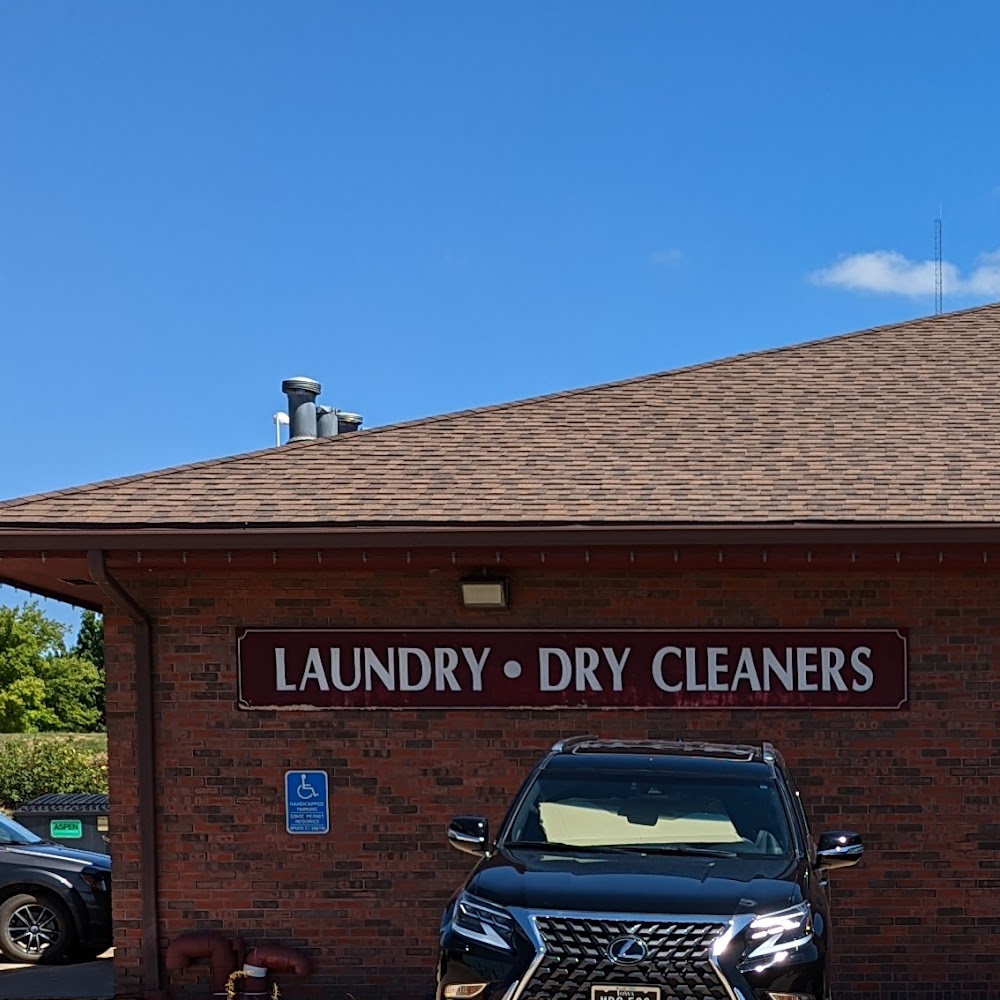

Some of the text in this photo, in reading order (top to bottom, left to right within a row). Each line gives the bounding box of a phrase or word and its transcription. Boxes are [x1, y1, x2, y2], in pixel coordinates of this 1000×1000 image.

[275, 646, 875, 693] LAUNDRY DRY CLEANERS
[54, 822, 79, 831] ASPEN
